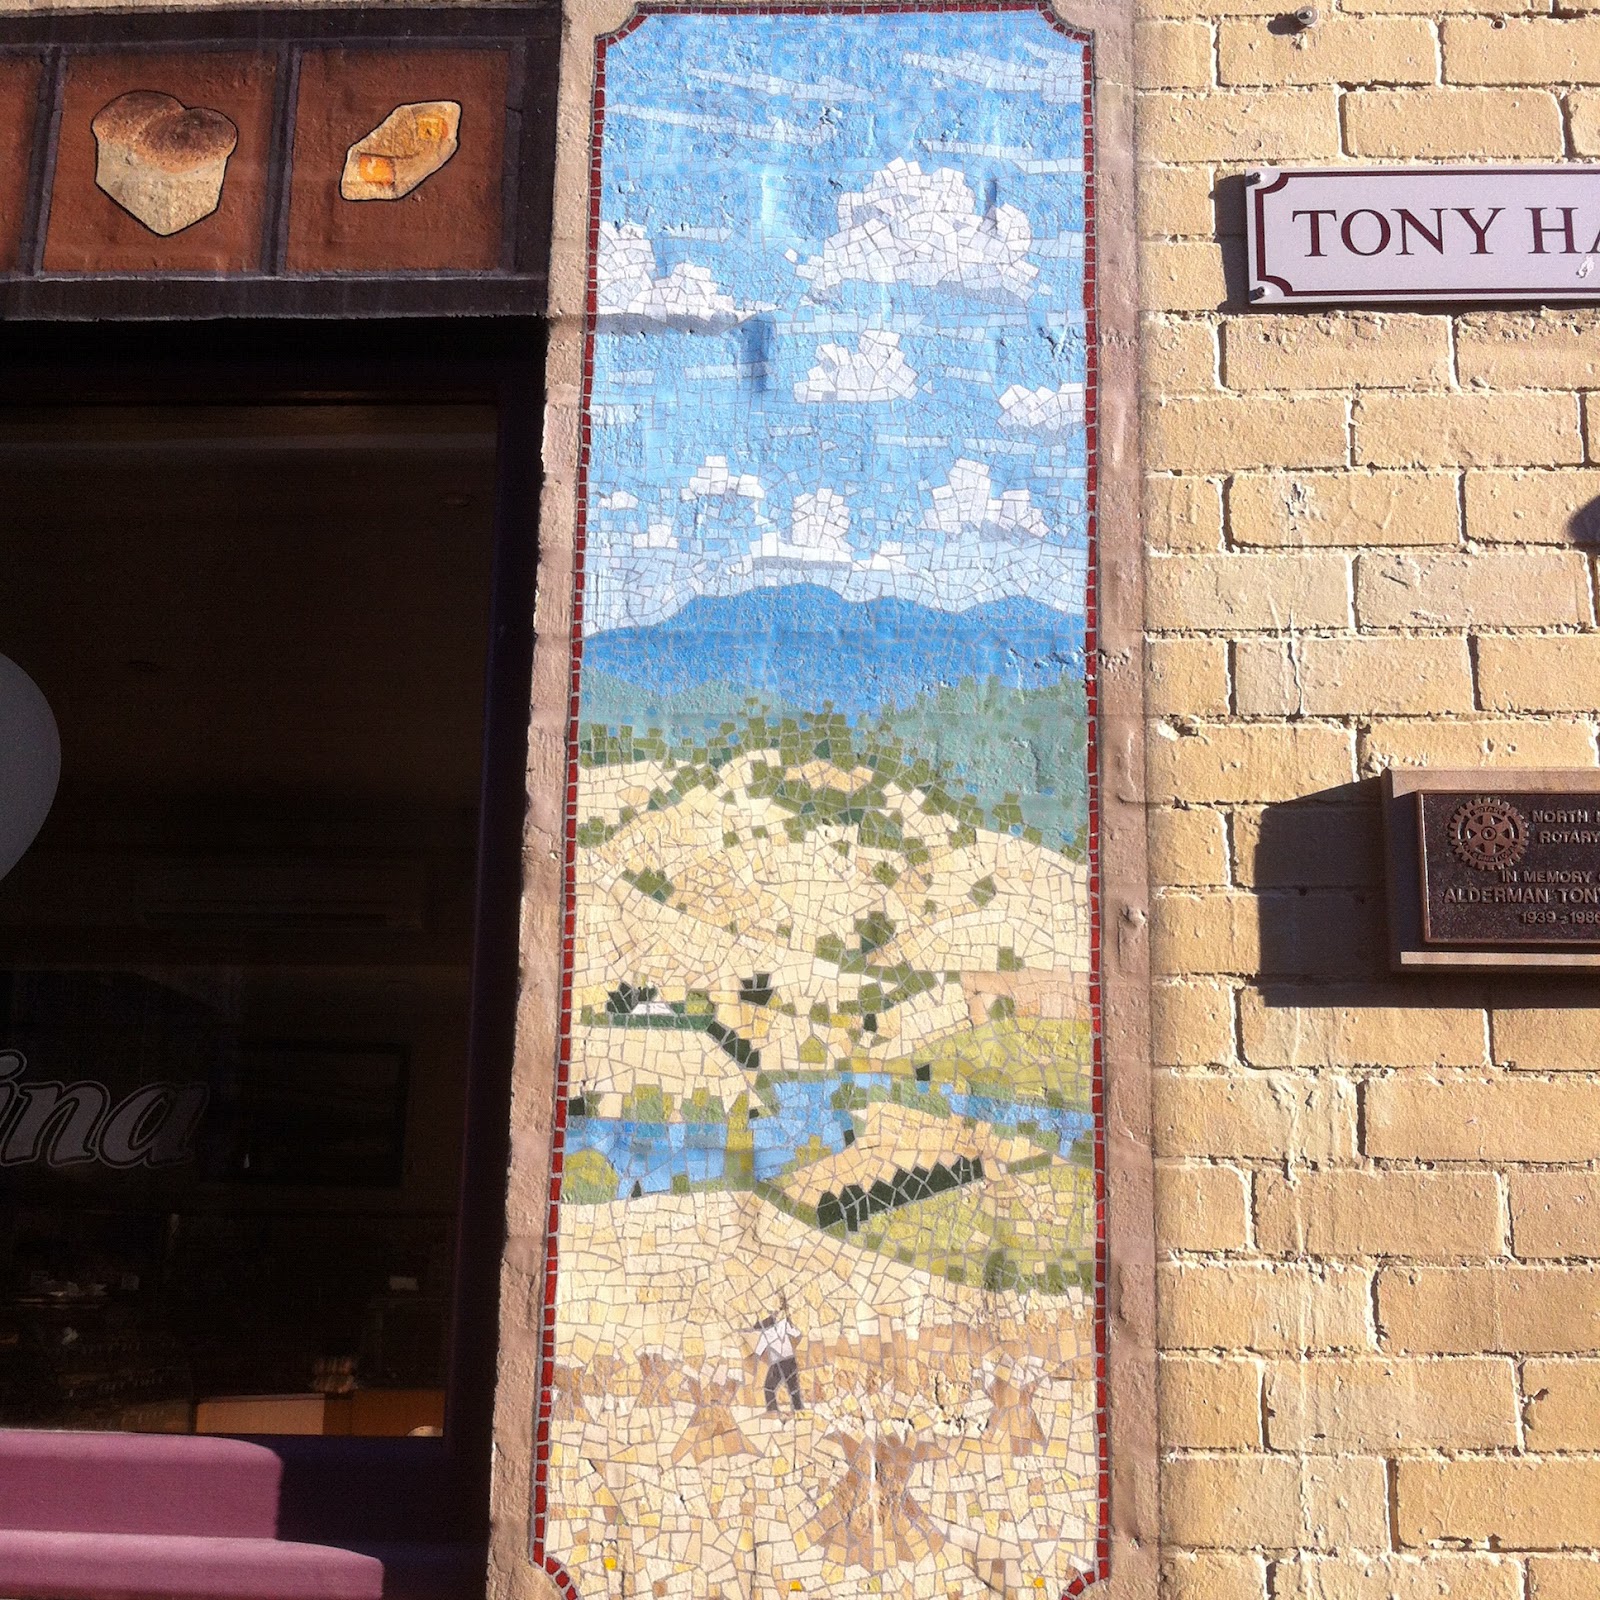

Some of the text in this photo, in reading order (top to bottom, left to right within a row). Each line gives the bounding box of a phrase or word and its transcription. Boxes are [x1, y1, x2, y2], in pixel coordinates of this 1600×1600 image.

[1292, 206, 1600, 257] TONY H
[1532, 809, 1588, 823] NORTH
[1540, 830, 1600, 844] ROTARY
[1502, 870, 1517, 882] IN
[1523, 870, 1592, 883] MEMORY
[1443, 887, 1600, 903] ALDERMAN TON
[1523, 910, 1557, 924] 1939
